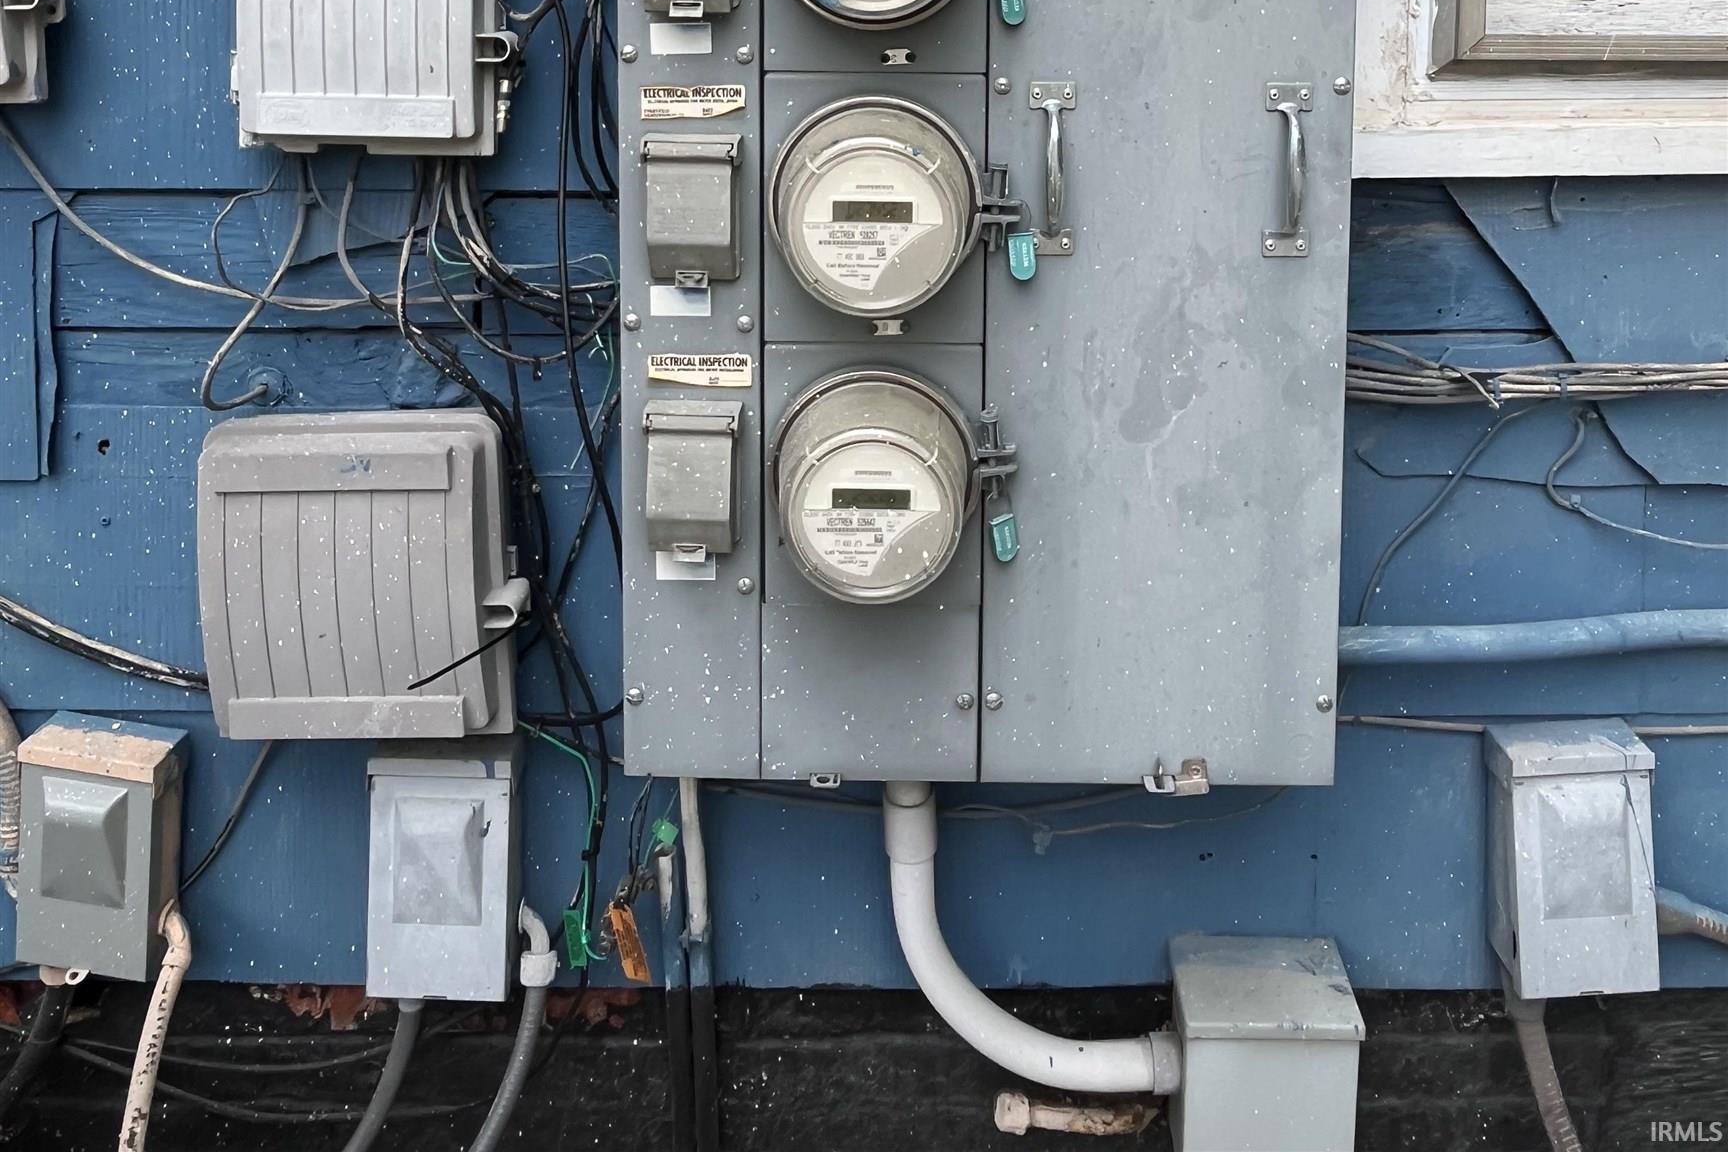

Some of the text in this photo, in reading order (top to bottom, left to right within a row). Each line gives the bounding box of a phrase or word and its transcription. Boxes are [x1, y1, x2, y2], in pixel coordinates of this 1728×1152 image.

[643, 87, 742, 98] ELECTRICAL INSPECTION
[828, 230, 856, 239] VECTREN
[651, 356, 748, 367] ELECTRICAL INSPECTION
[826, 517, 853, 527] VECTREN
